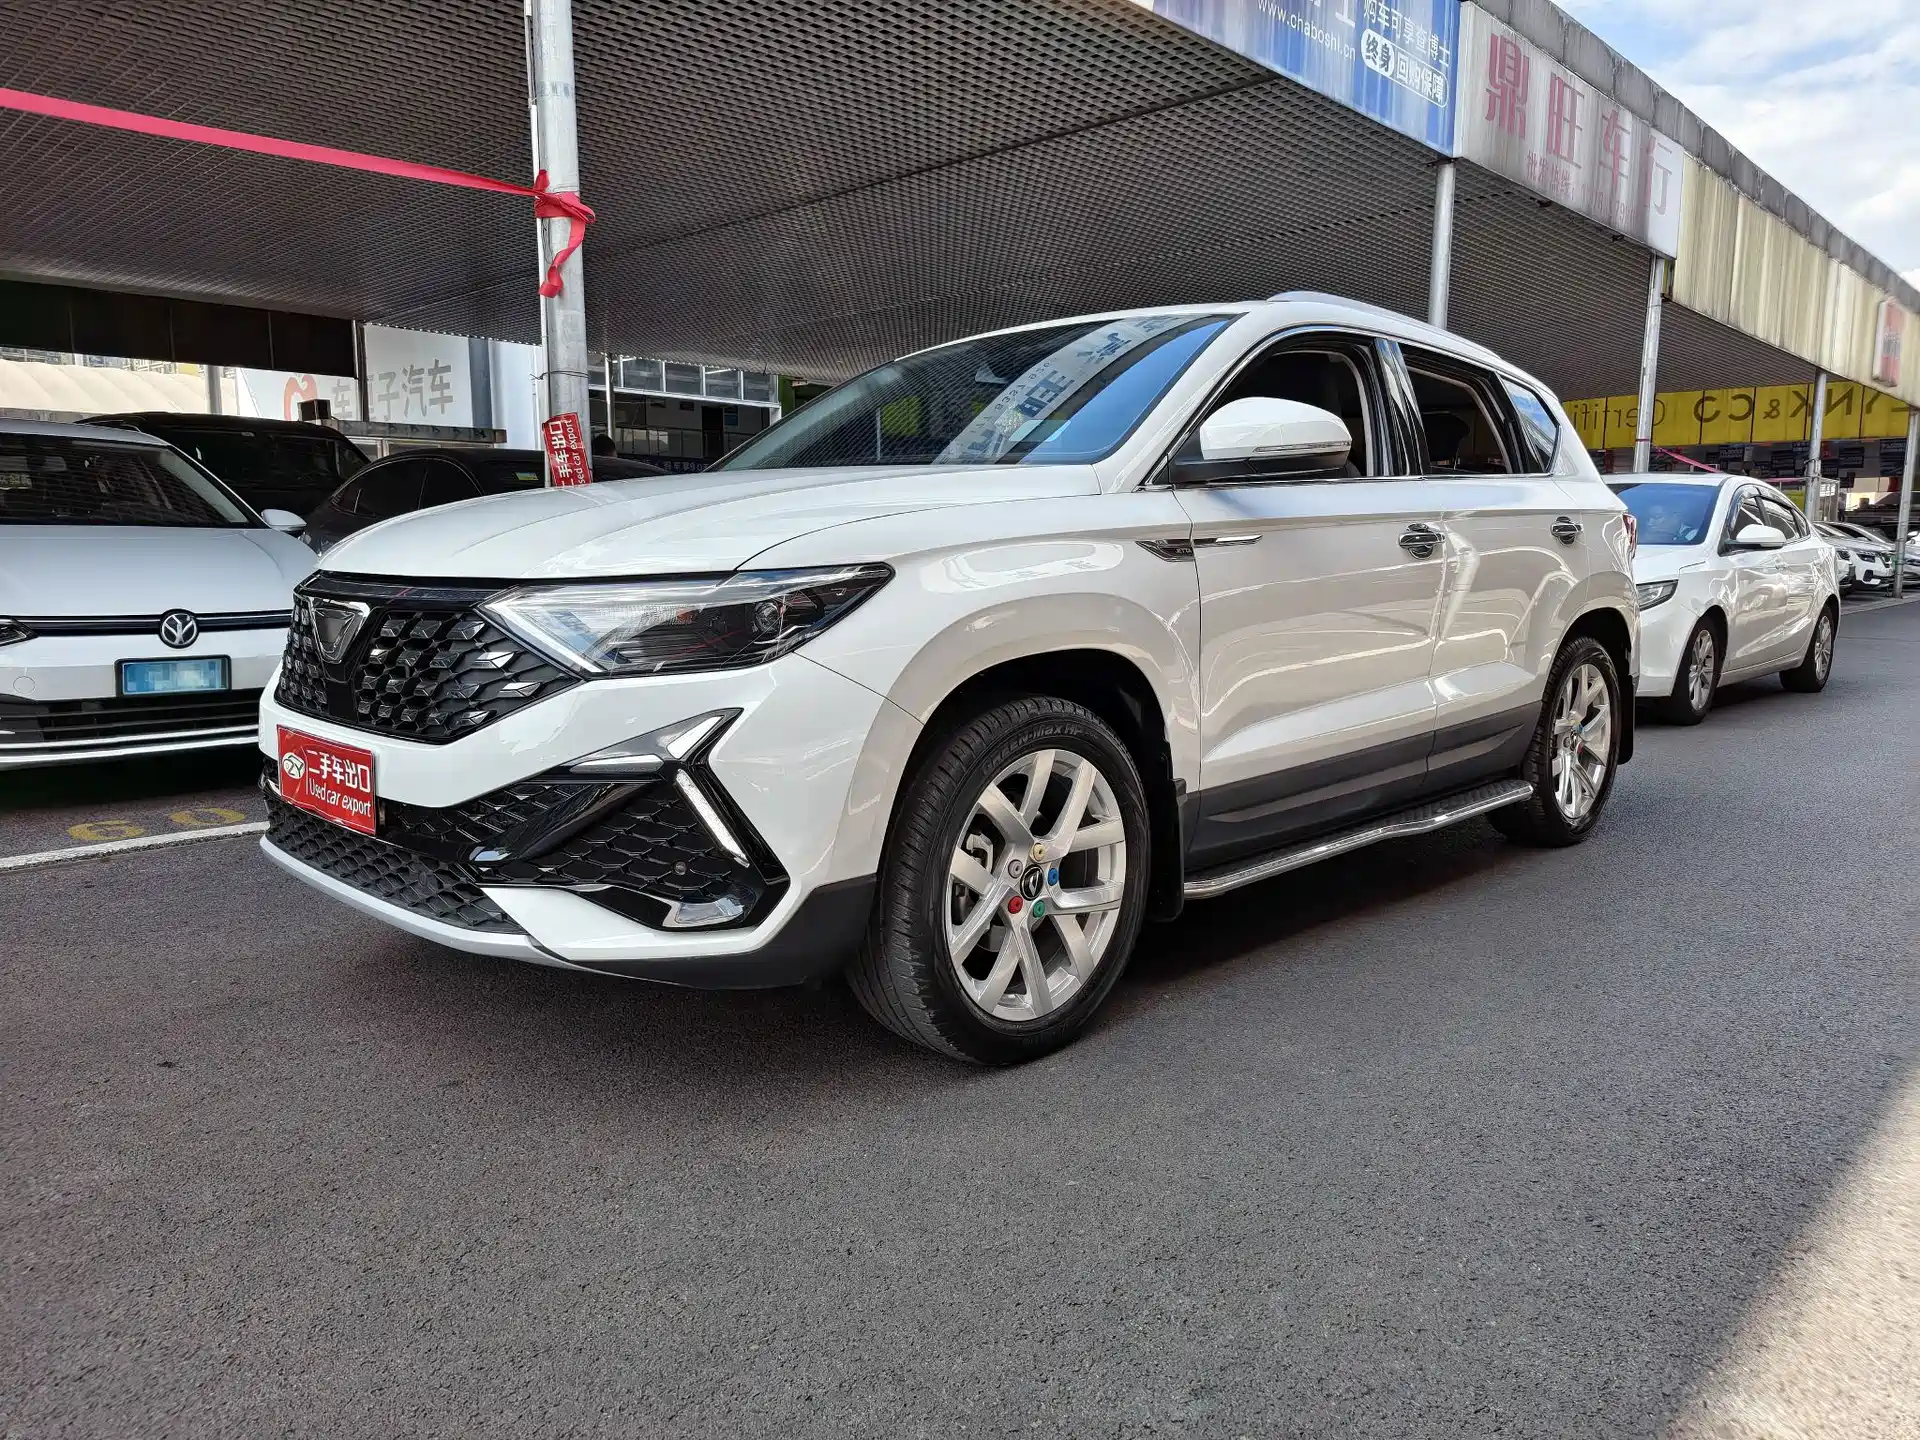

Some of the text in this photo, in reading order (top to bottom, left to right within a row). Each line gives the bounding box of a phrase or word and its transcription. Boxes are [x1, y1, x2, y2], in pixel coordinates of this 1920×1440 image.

[1257, 0, 1356, 61] www.chaboshi.cn
[1363, 0, 1450, 68] 购车可享查博士
[1365, 33, 1391, 72] 终身
[1484, 32, 1673, 216] 鼎旺车行
[331, 359, 454, 422] 车子汽车
[565, 419, 578, 450] export
[572, 452, 581, 466] car
[306, 748, 371, 794] 二手车出口
[308, 776, 372, 818] Used car export
